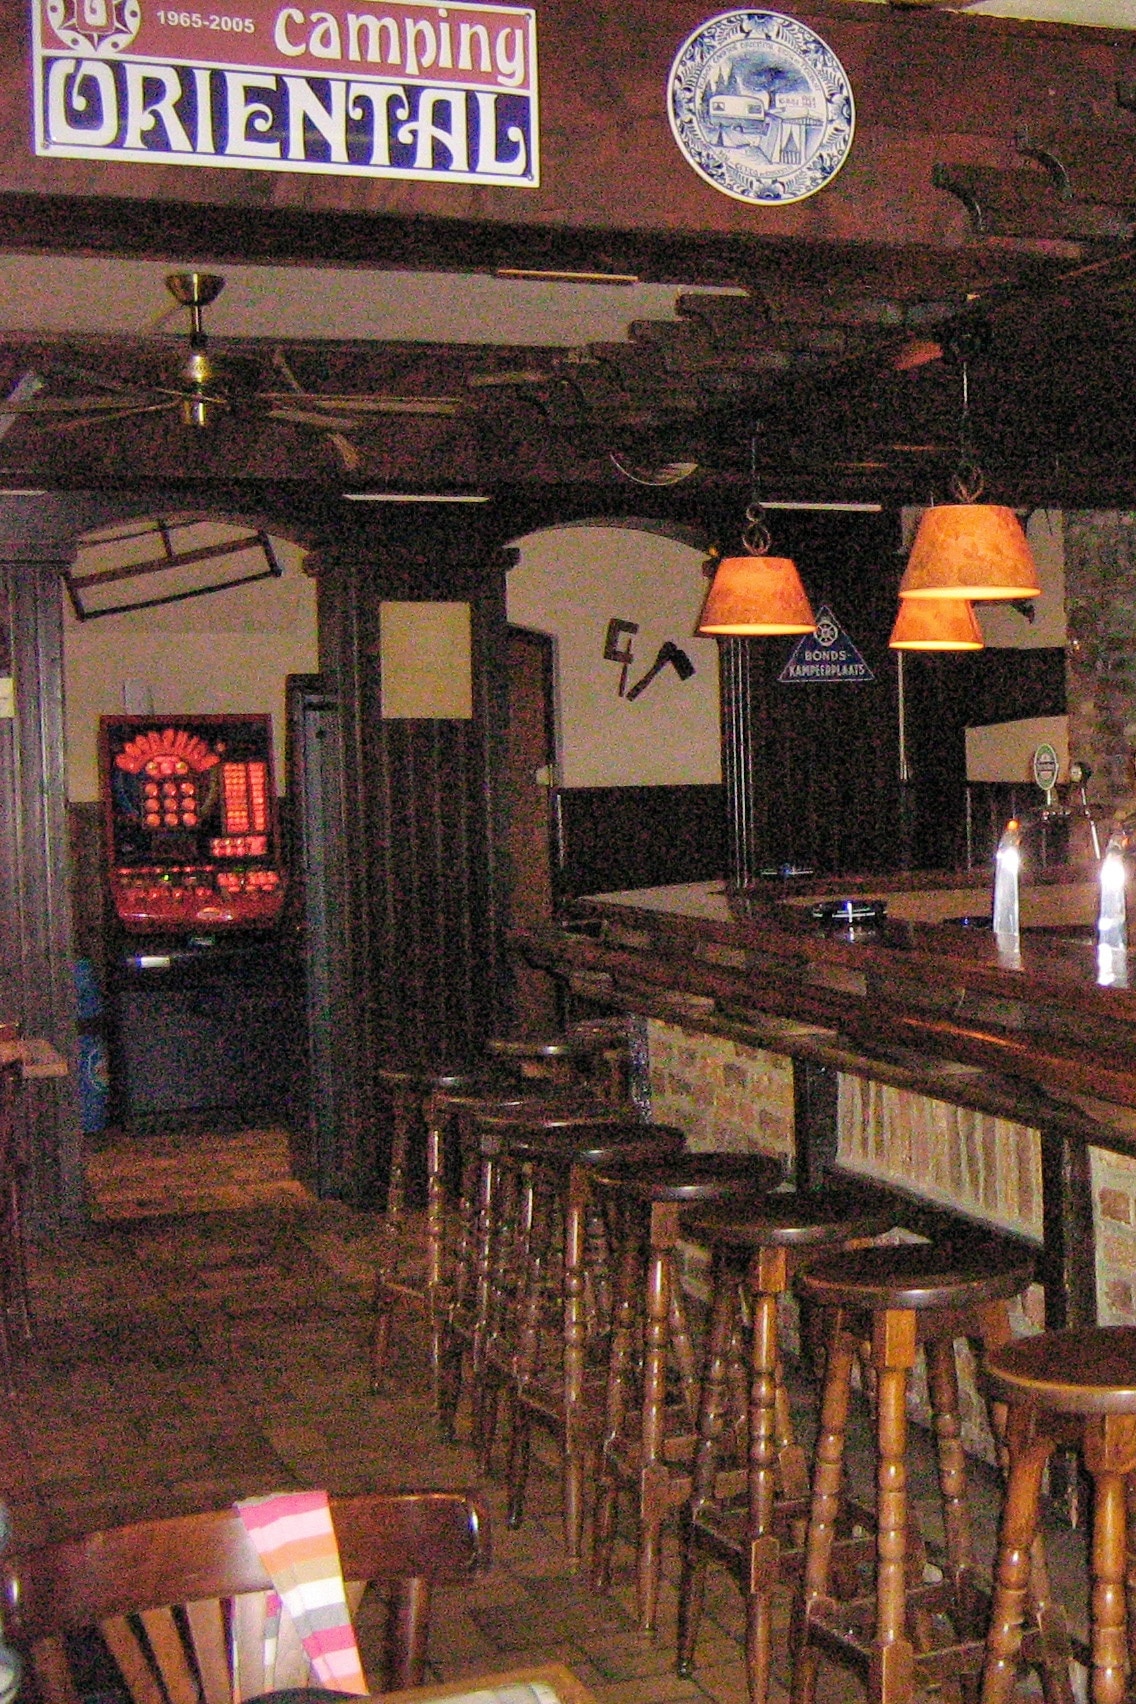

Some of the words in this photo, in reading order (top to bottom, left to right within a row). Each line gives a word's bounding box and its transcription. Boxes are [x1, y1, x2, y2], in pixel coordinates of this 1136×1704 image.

[156, 10, 255, 34] 1965-2005
[273, 7, 525, 87] camping
[47, 57, 528, 176] ORIENTAL
